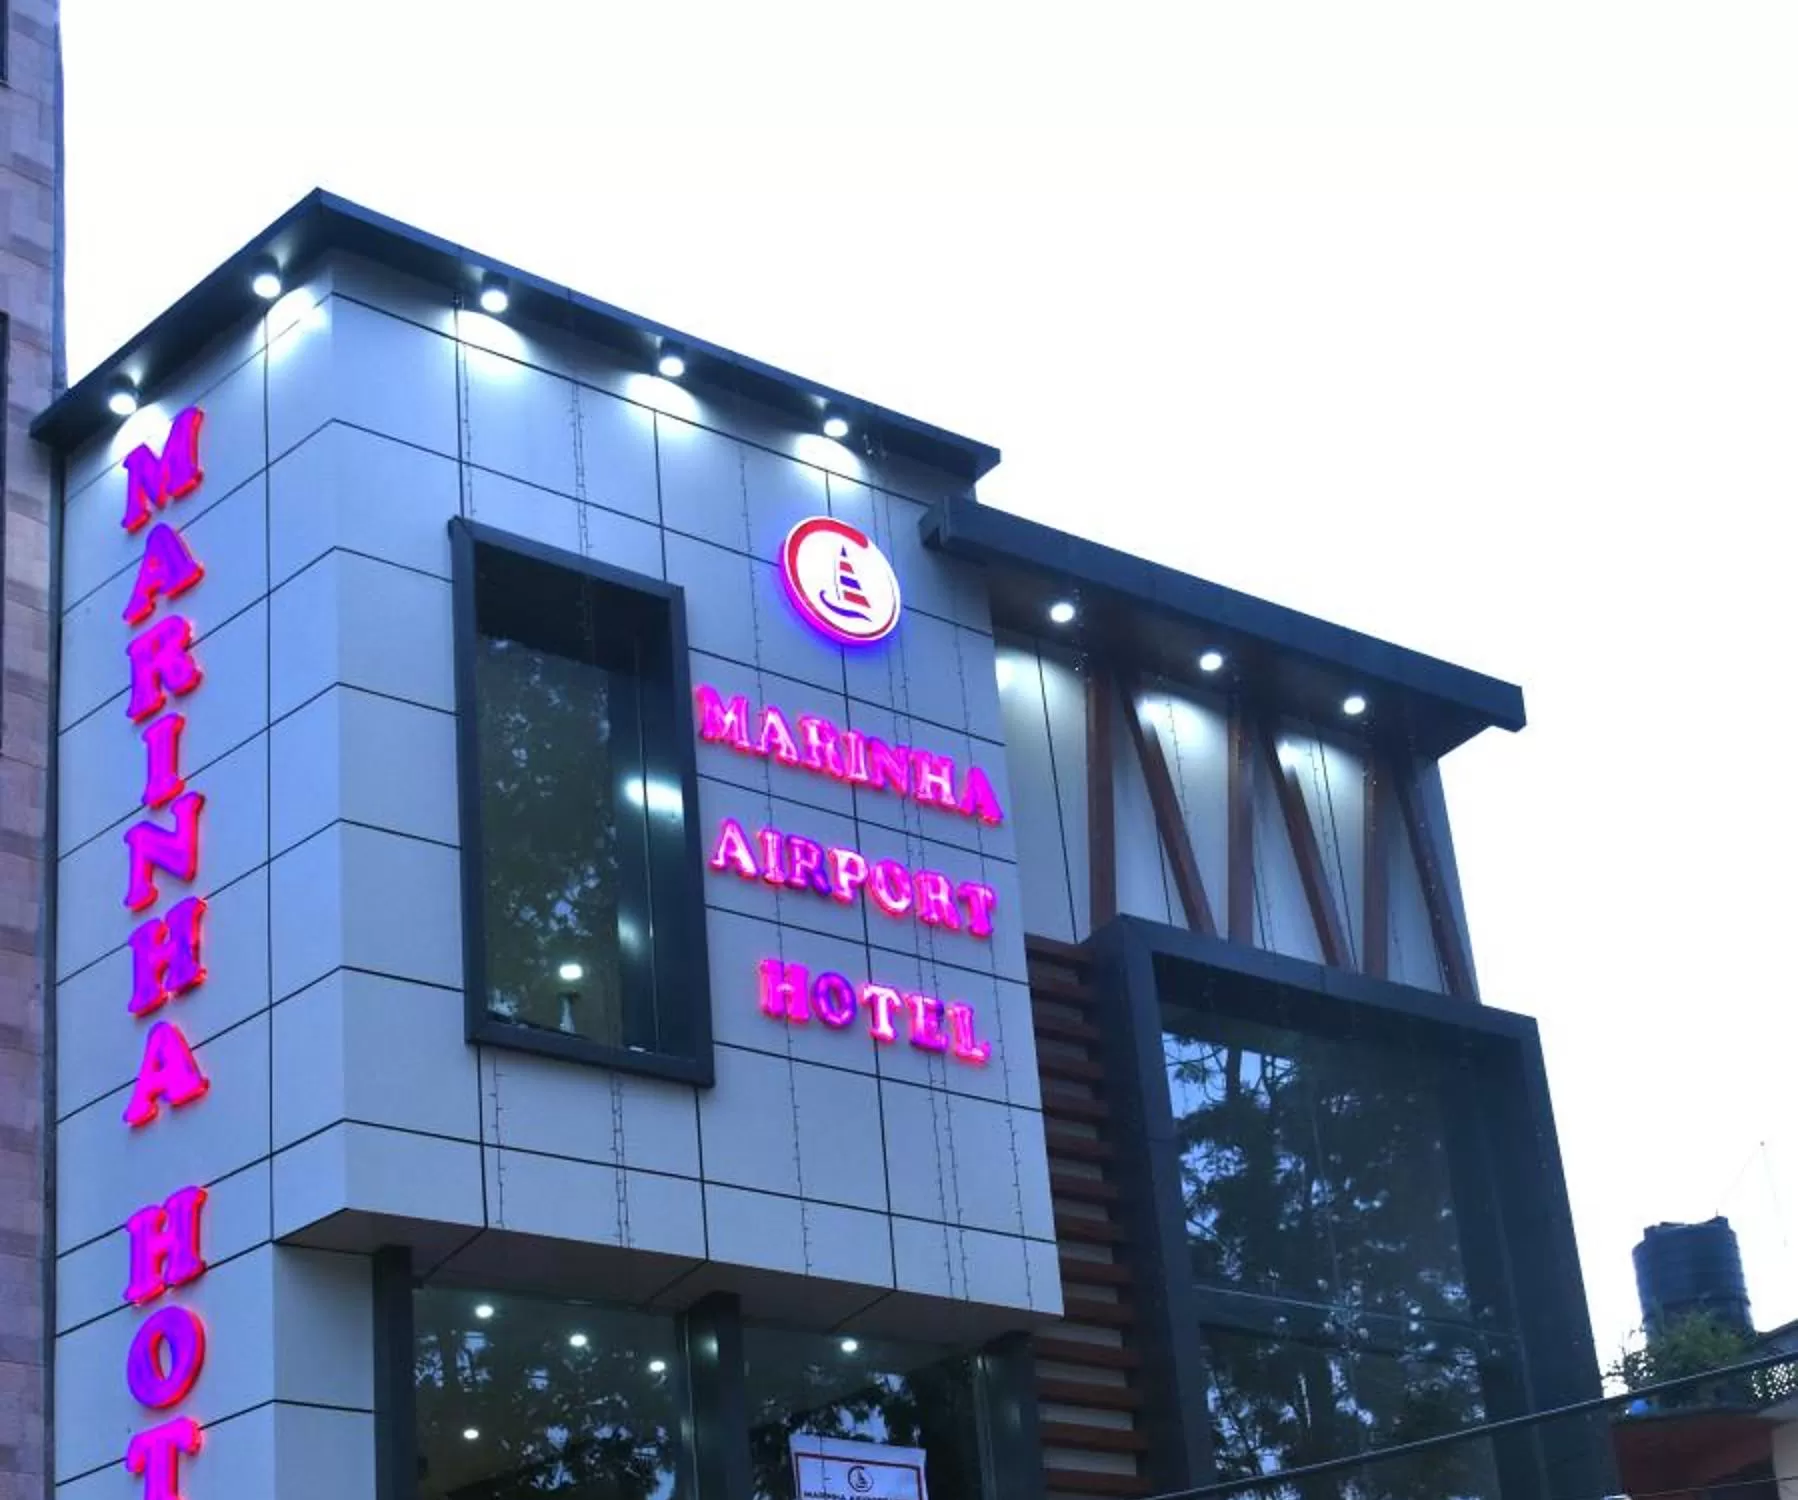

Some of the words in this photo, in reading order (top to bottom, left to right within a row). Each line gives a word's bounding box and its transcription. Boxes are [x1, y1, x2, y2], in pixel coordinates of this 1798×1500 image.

[121, 405, 210, 1129] MARINHA
[695, 685, 1004, 824] MARINHA
[709, 817, 995, 937] AIRPORT
[758, 957, 991, 1062] HOTEL
